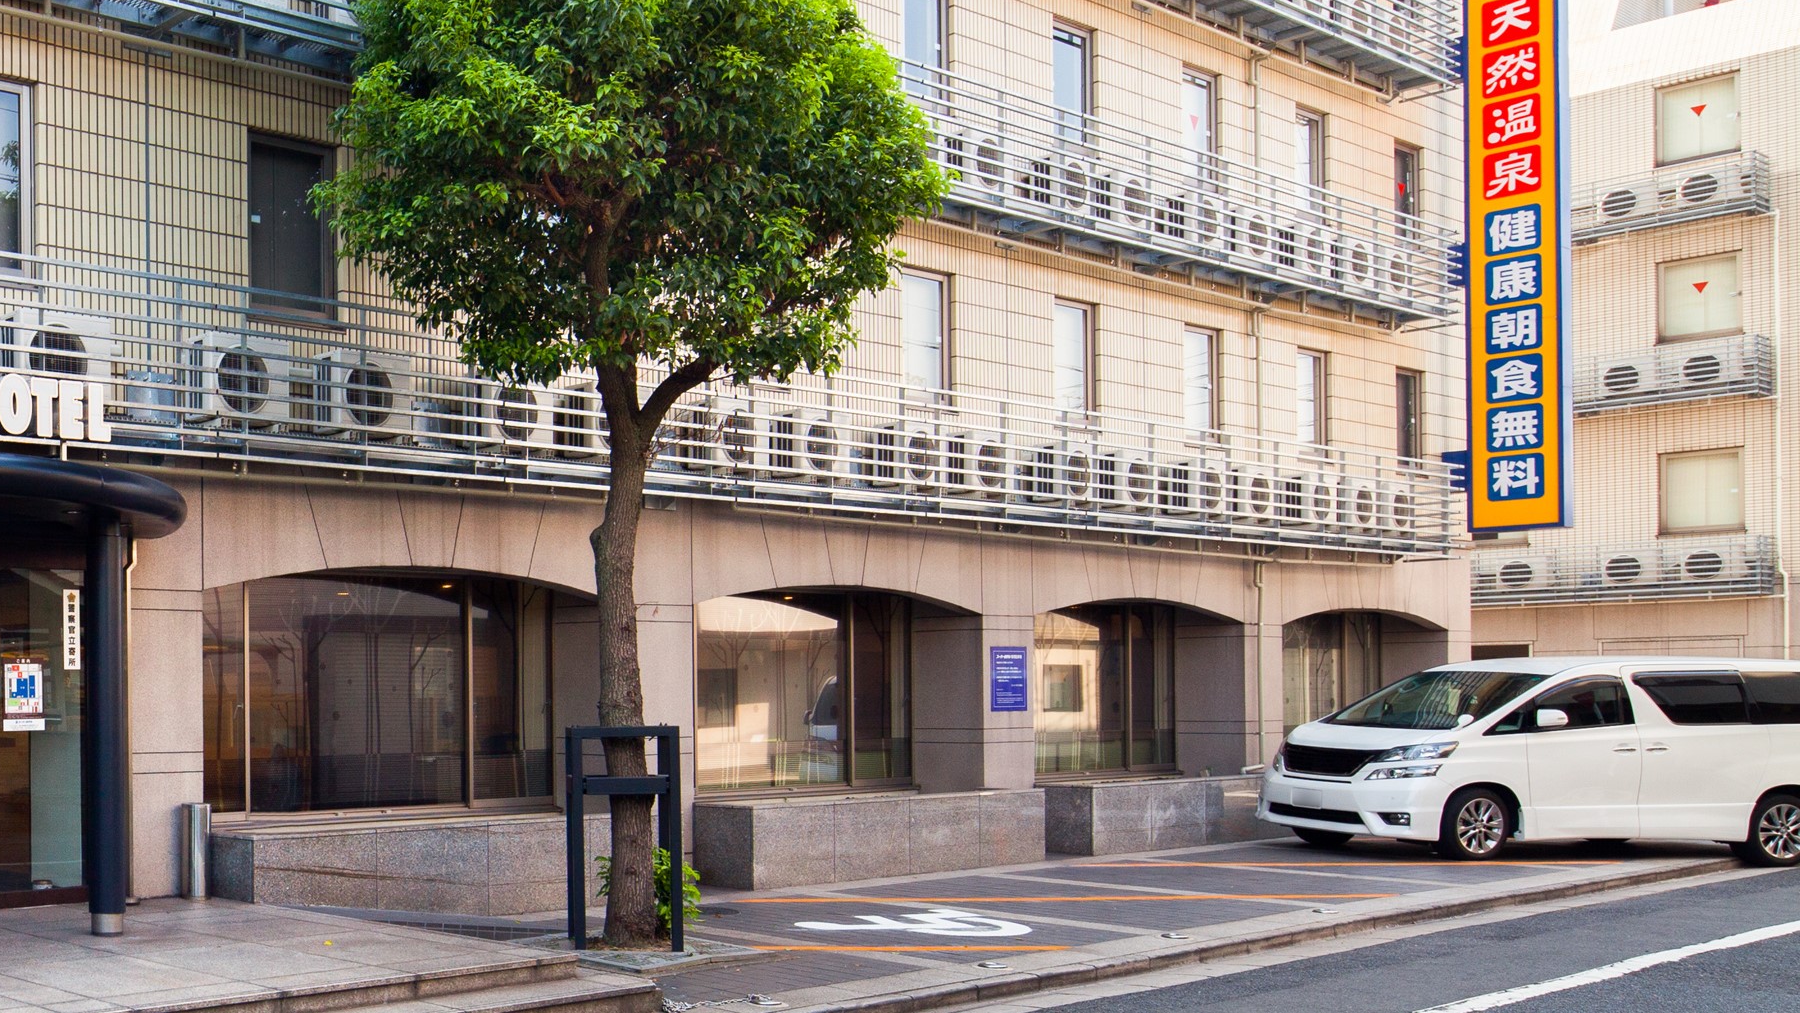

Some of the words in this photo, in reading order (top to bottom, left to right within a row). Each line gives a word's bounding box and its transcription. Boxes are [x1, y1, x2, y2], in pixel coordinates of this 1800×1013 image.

[1488, 210, 1541, 498] 健康朝食無料
